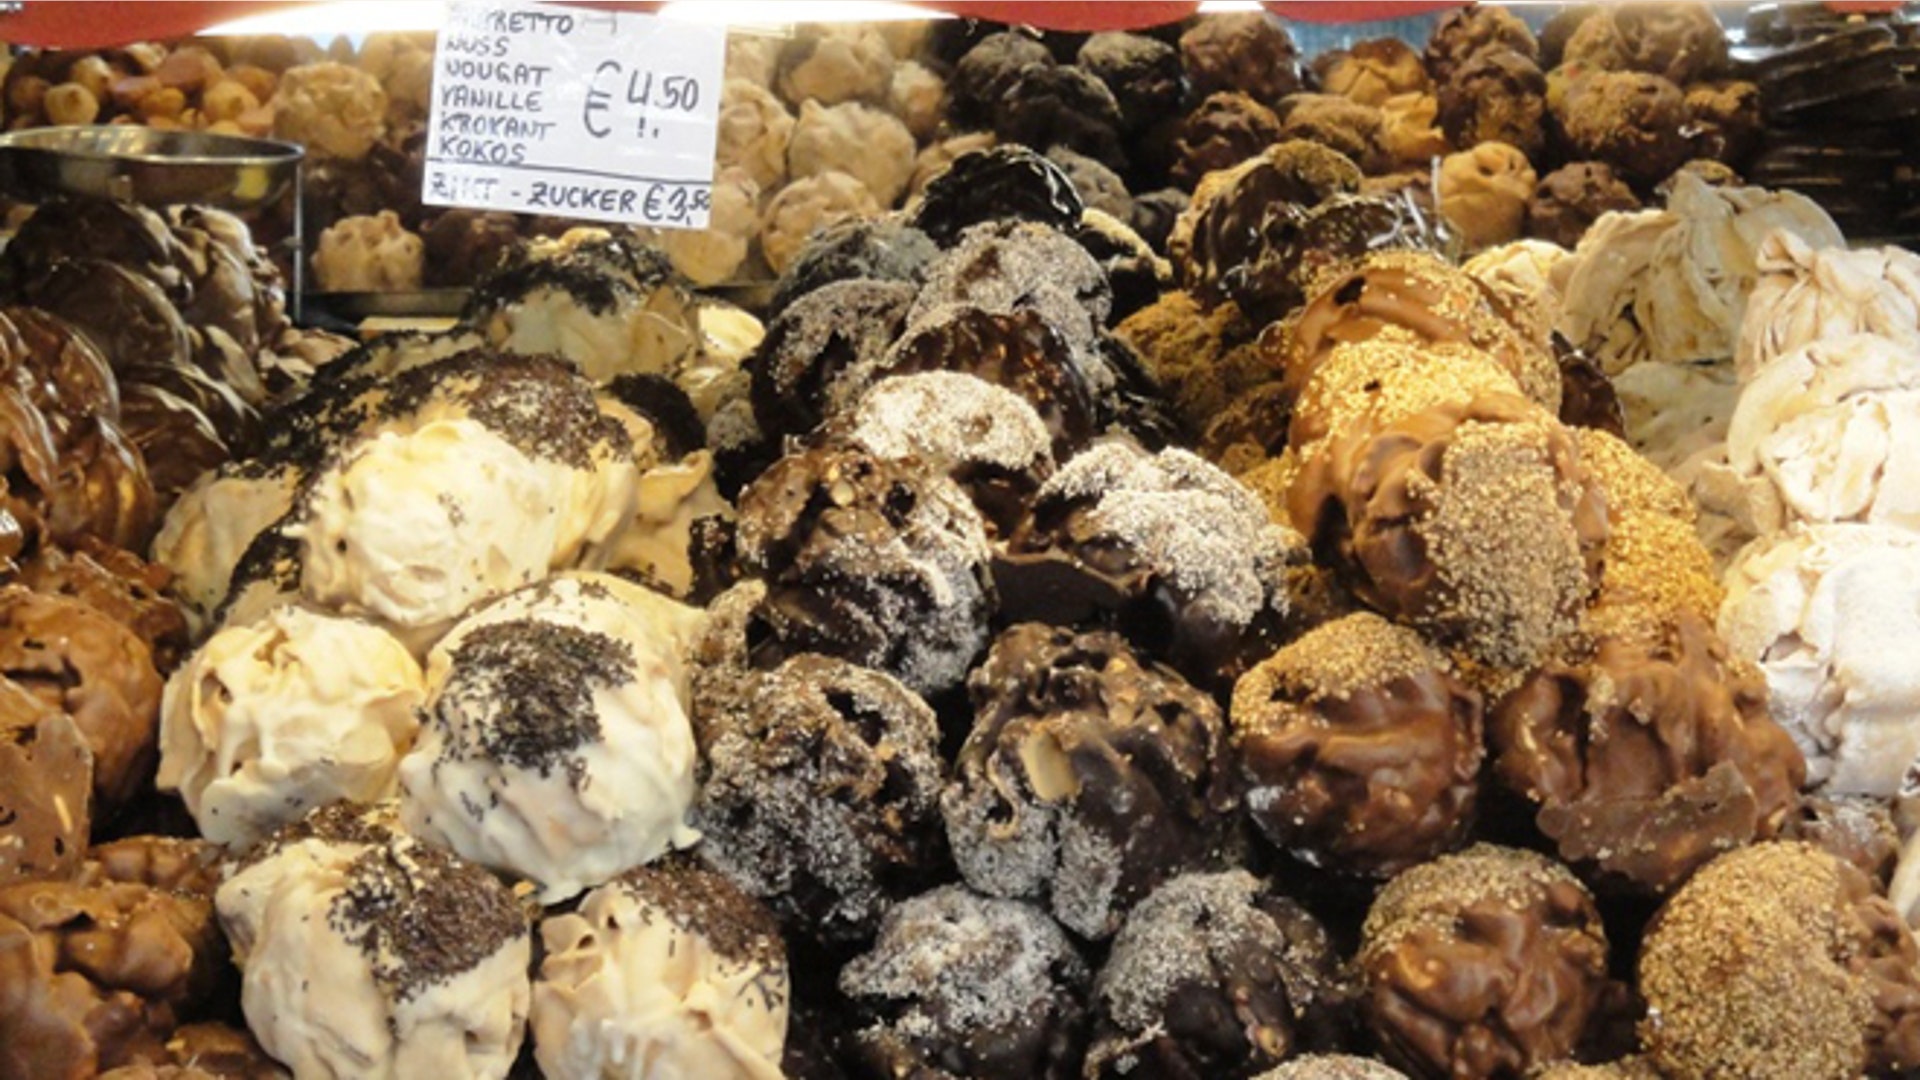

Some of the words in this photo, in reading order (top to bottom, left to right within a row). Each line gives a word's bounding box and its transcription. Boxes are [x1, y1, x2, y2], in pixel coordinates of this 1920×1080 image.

[445, 34, 510, 57] NUSS
[441, 84, 543, 113] VANILLE
[440, 111, 557, 141] KROKANT
[439, 134, 527, 166] KOKOS
[526, 181, 637, 213] ZUCKER
